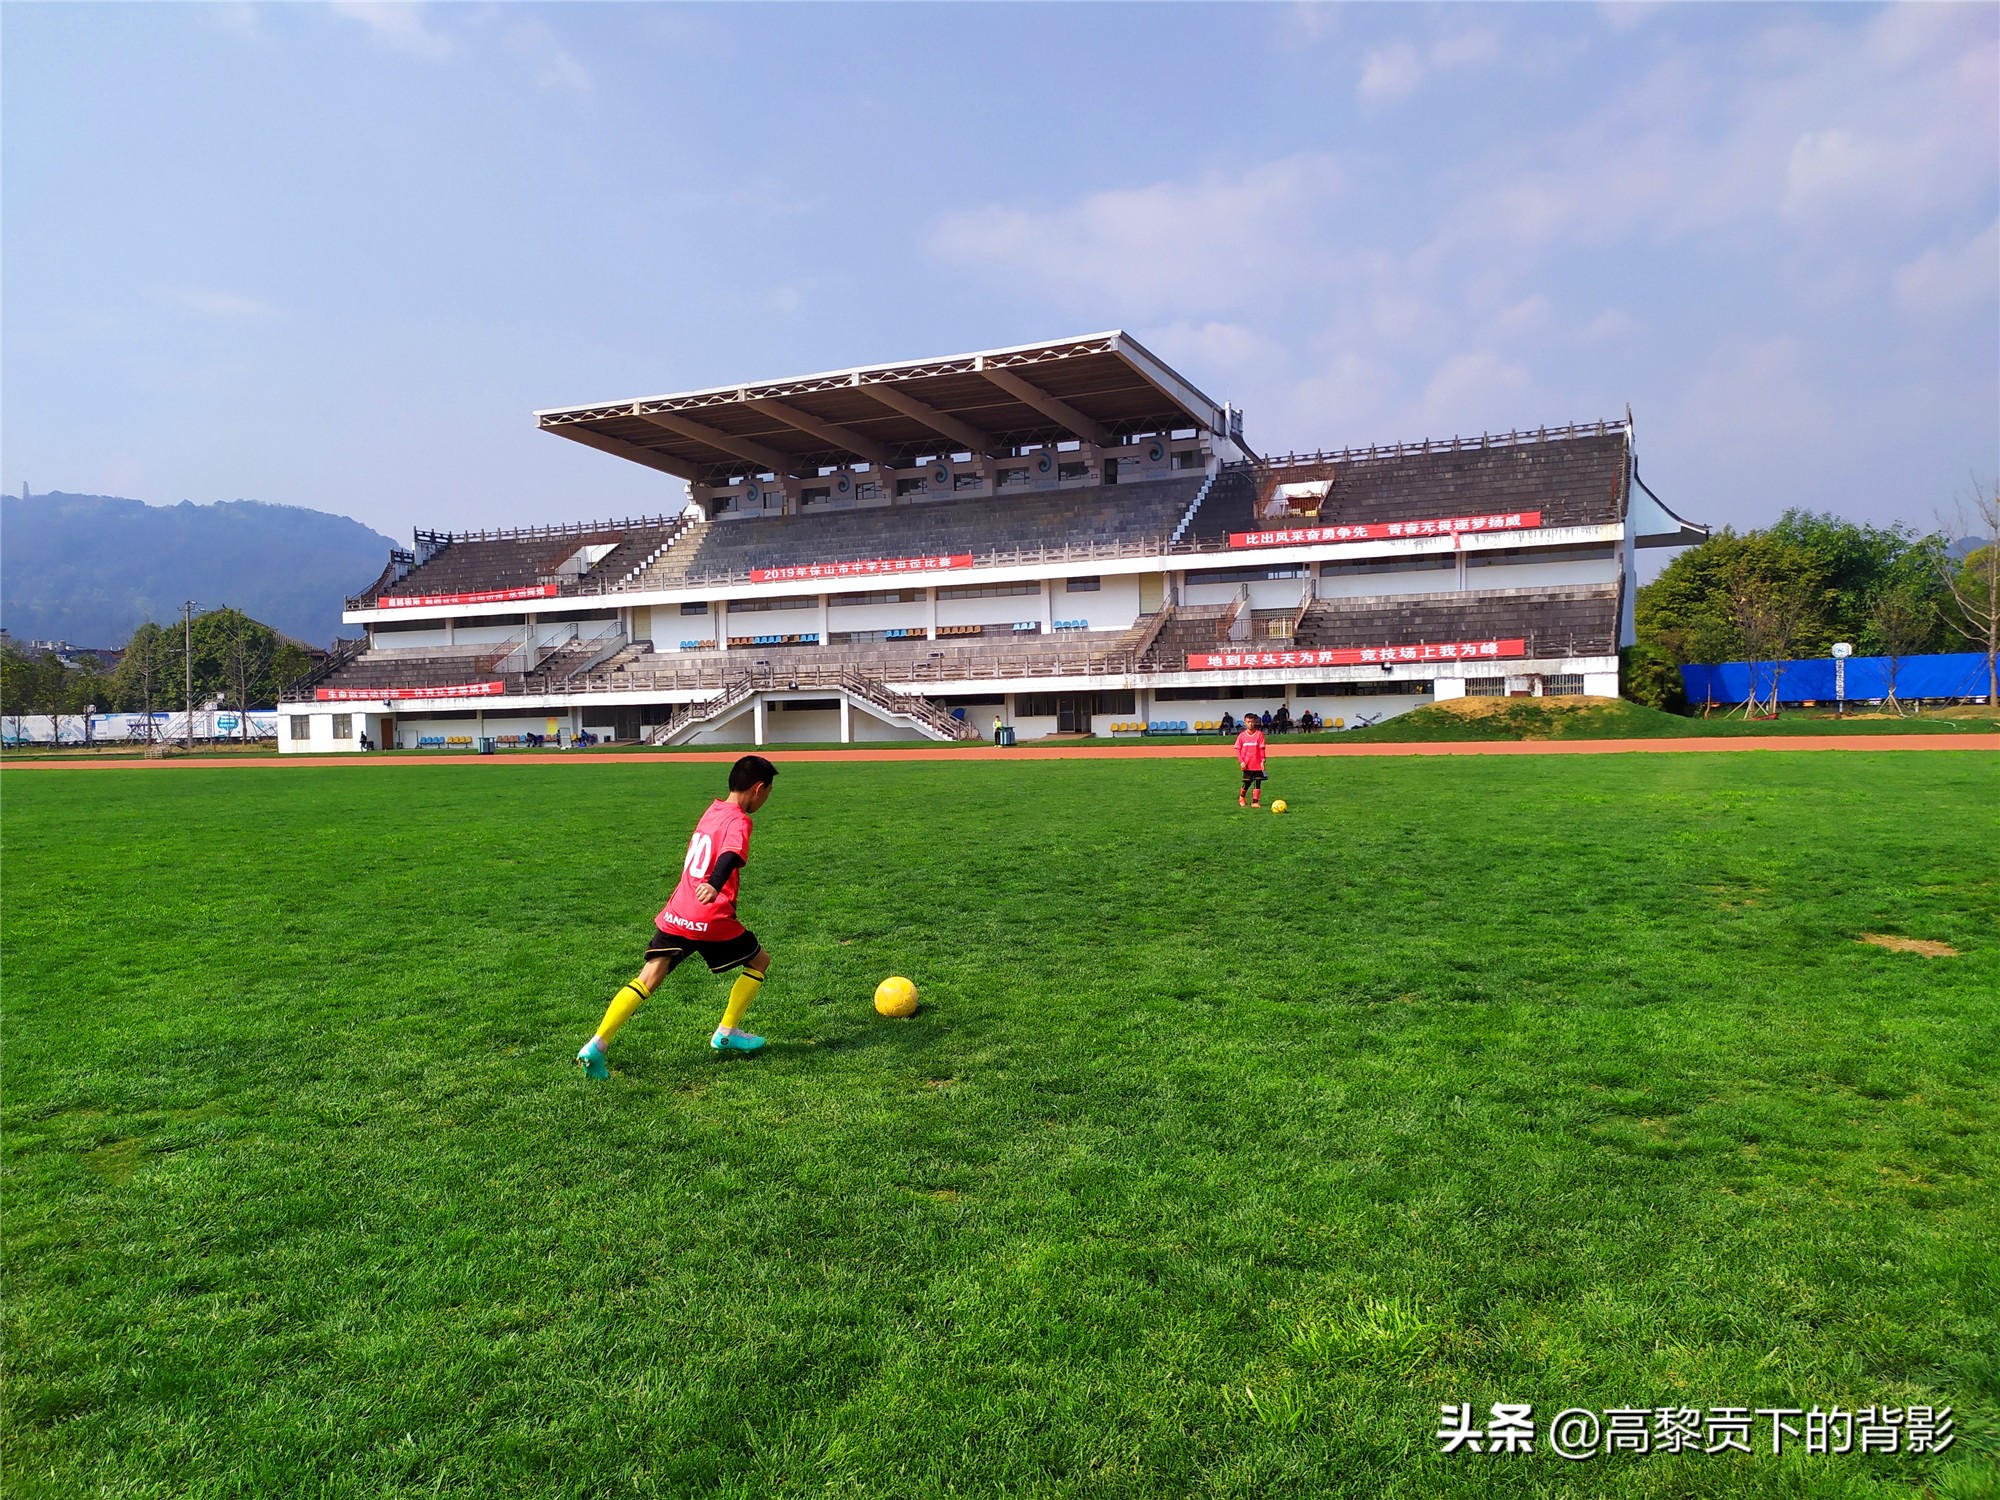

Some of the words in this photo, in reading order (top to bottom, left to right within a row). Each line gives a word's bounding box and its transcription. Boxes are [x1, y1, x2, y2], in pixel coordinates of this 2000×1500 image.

[1246, 526, 1368, 545] 比出风采奋勇争先
[1387, 514, 1522, 535] 青春无畏逐梦扬威
[764, 557, 952, 580] 2019年保山市中学生田径比赛
[1206, 651, 1334, 667] 地到尽头天为界
